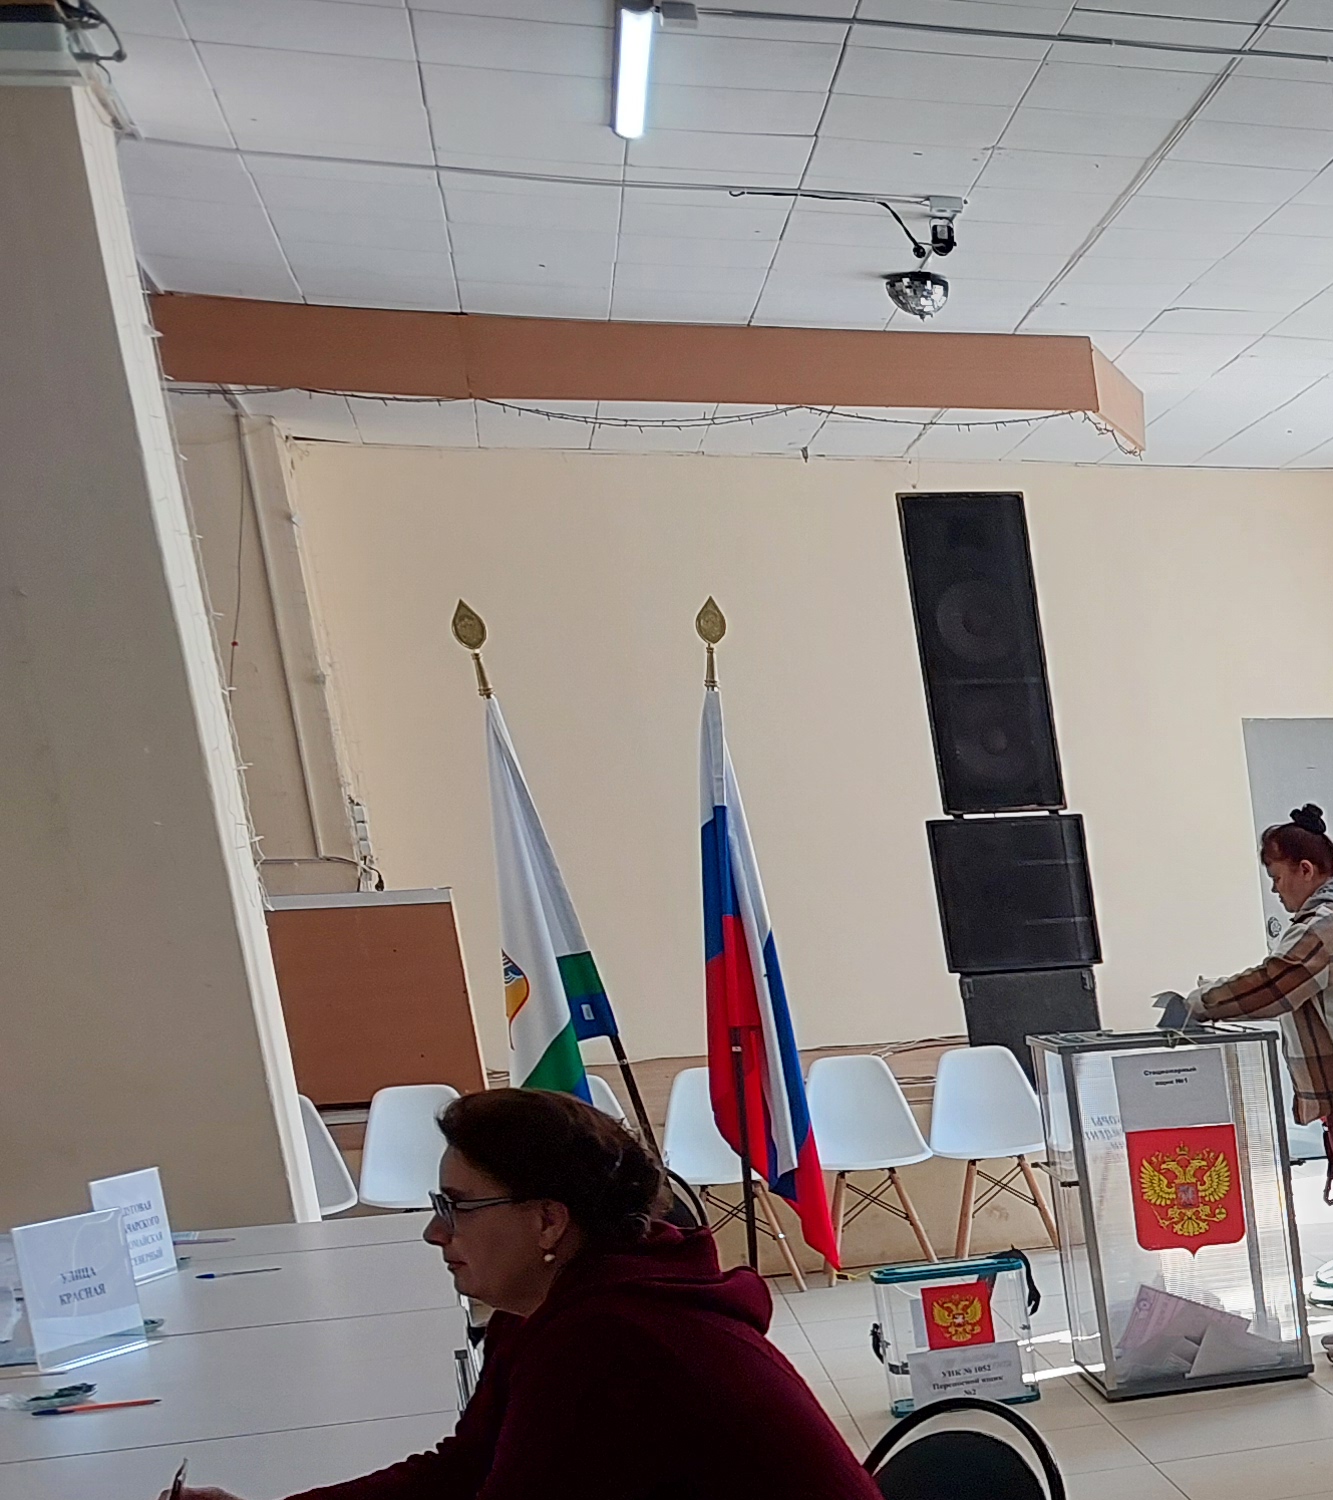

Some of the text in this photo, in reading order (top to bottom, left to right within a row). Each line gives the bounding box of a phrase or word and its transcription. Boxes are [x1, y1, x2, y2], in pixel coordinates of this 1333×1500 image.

[128, 1231, 163, 1249] ОМАЙСКАЯ
[60, 1266, 97, 1284] УЛИЦА
[59, 1283, 106, 1306] КРАСНАЯ
